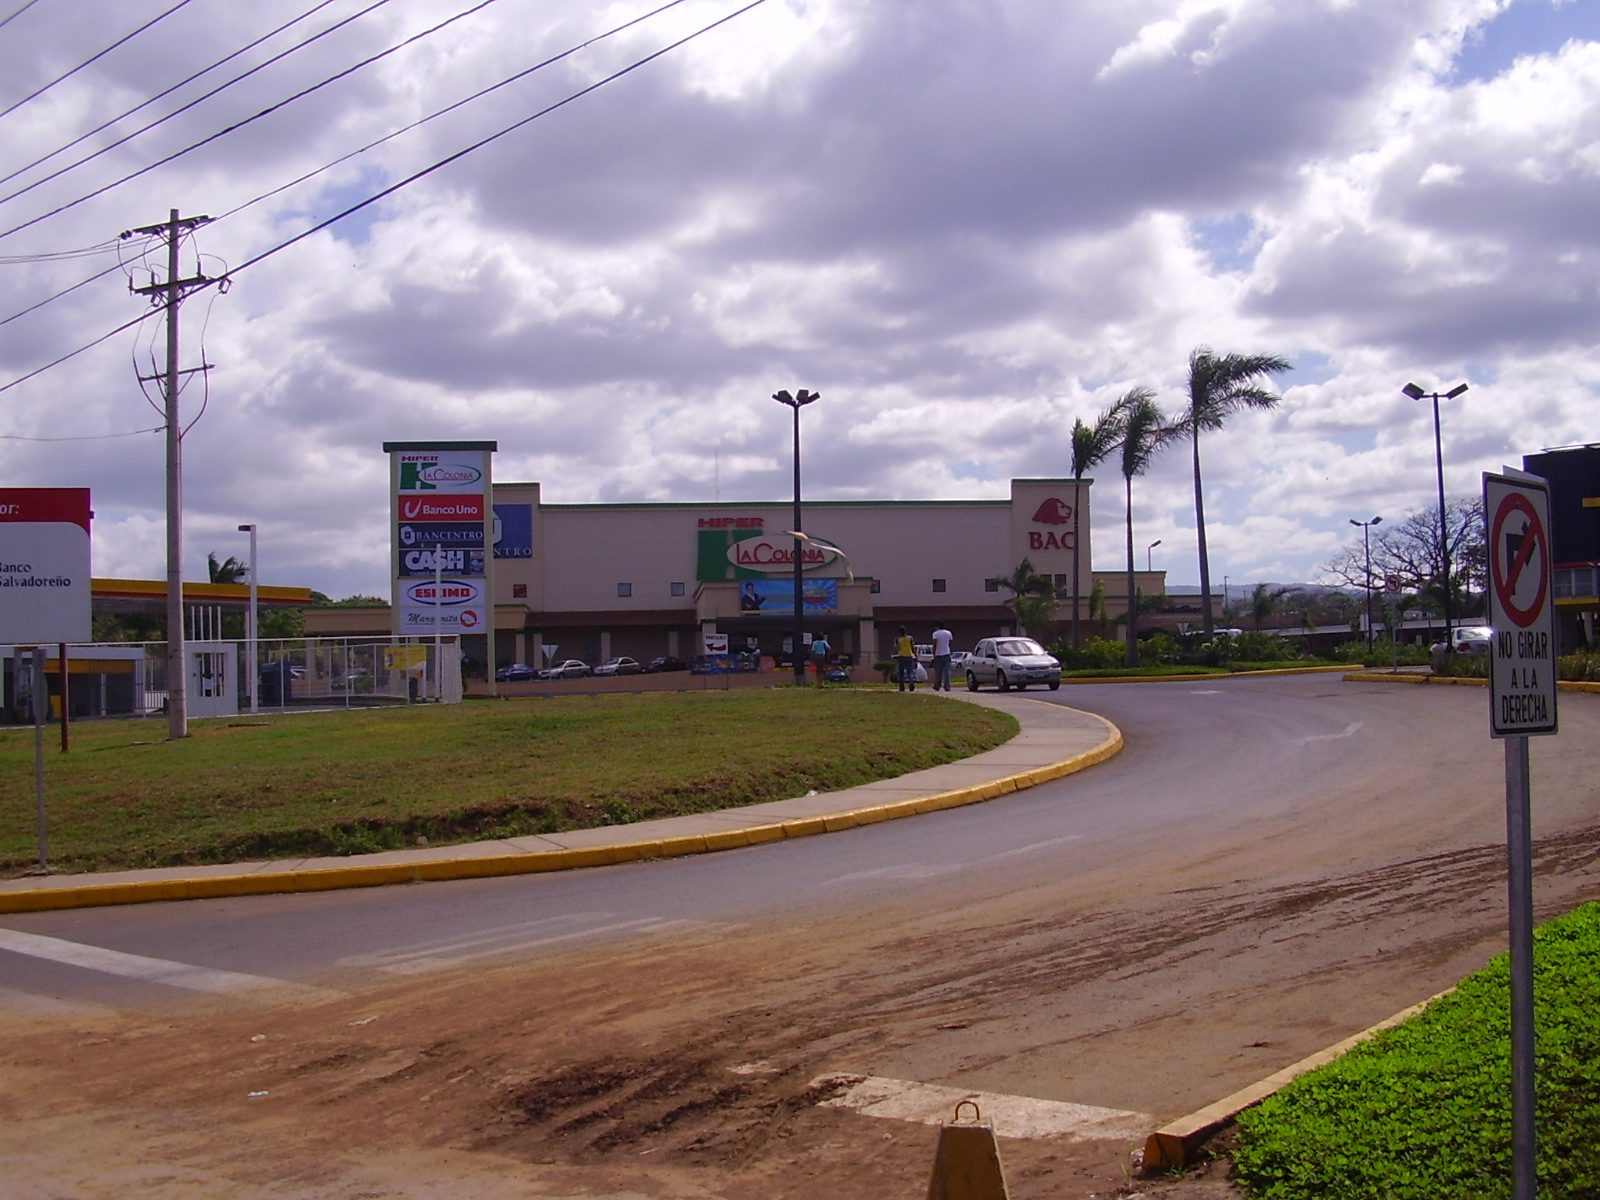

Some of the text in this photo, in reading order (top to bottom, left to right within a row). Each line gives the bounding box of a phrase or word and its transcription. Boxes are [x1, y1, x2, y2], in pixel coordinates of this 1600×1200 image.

[422, 505, 478, 515] Banco Uno
[698, 518, 764, 527] HIPER
[416, 531, 484, 540] BANCENTRO
[1028, 531, 1074, 550] BAC
[405, 551, 464, 570] CASH
[1498, 631, 1548, 660] NO GIRAR
[1510, 668, 1538, 688] A LA
[1502, 694, 1549, 724] DERECHA
